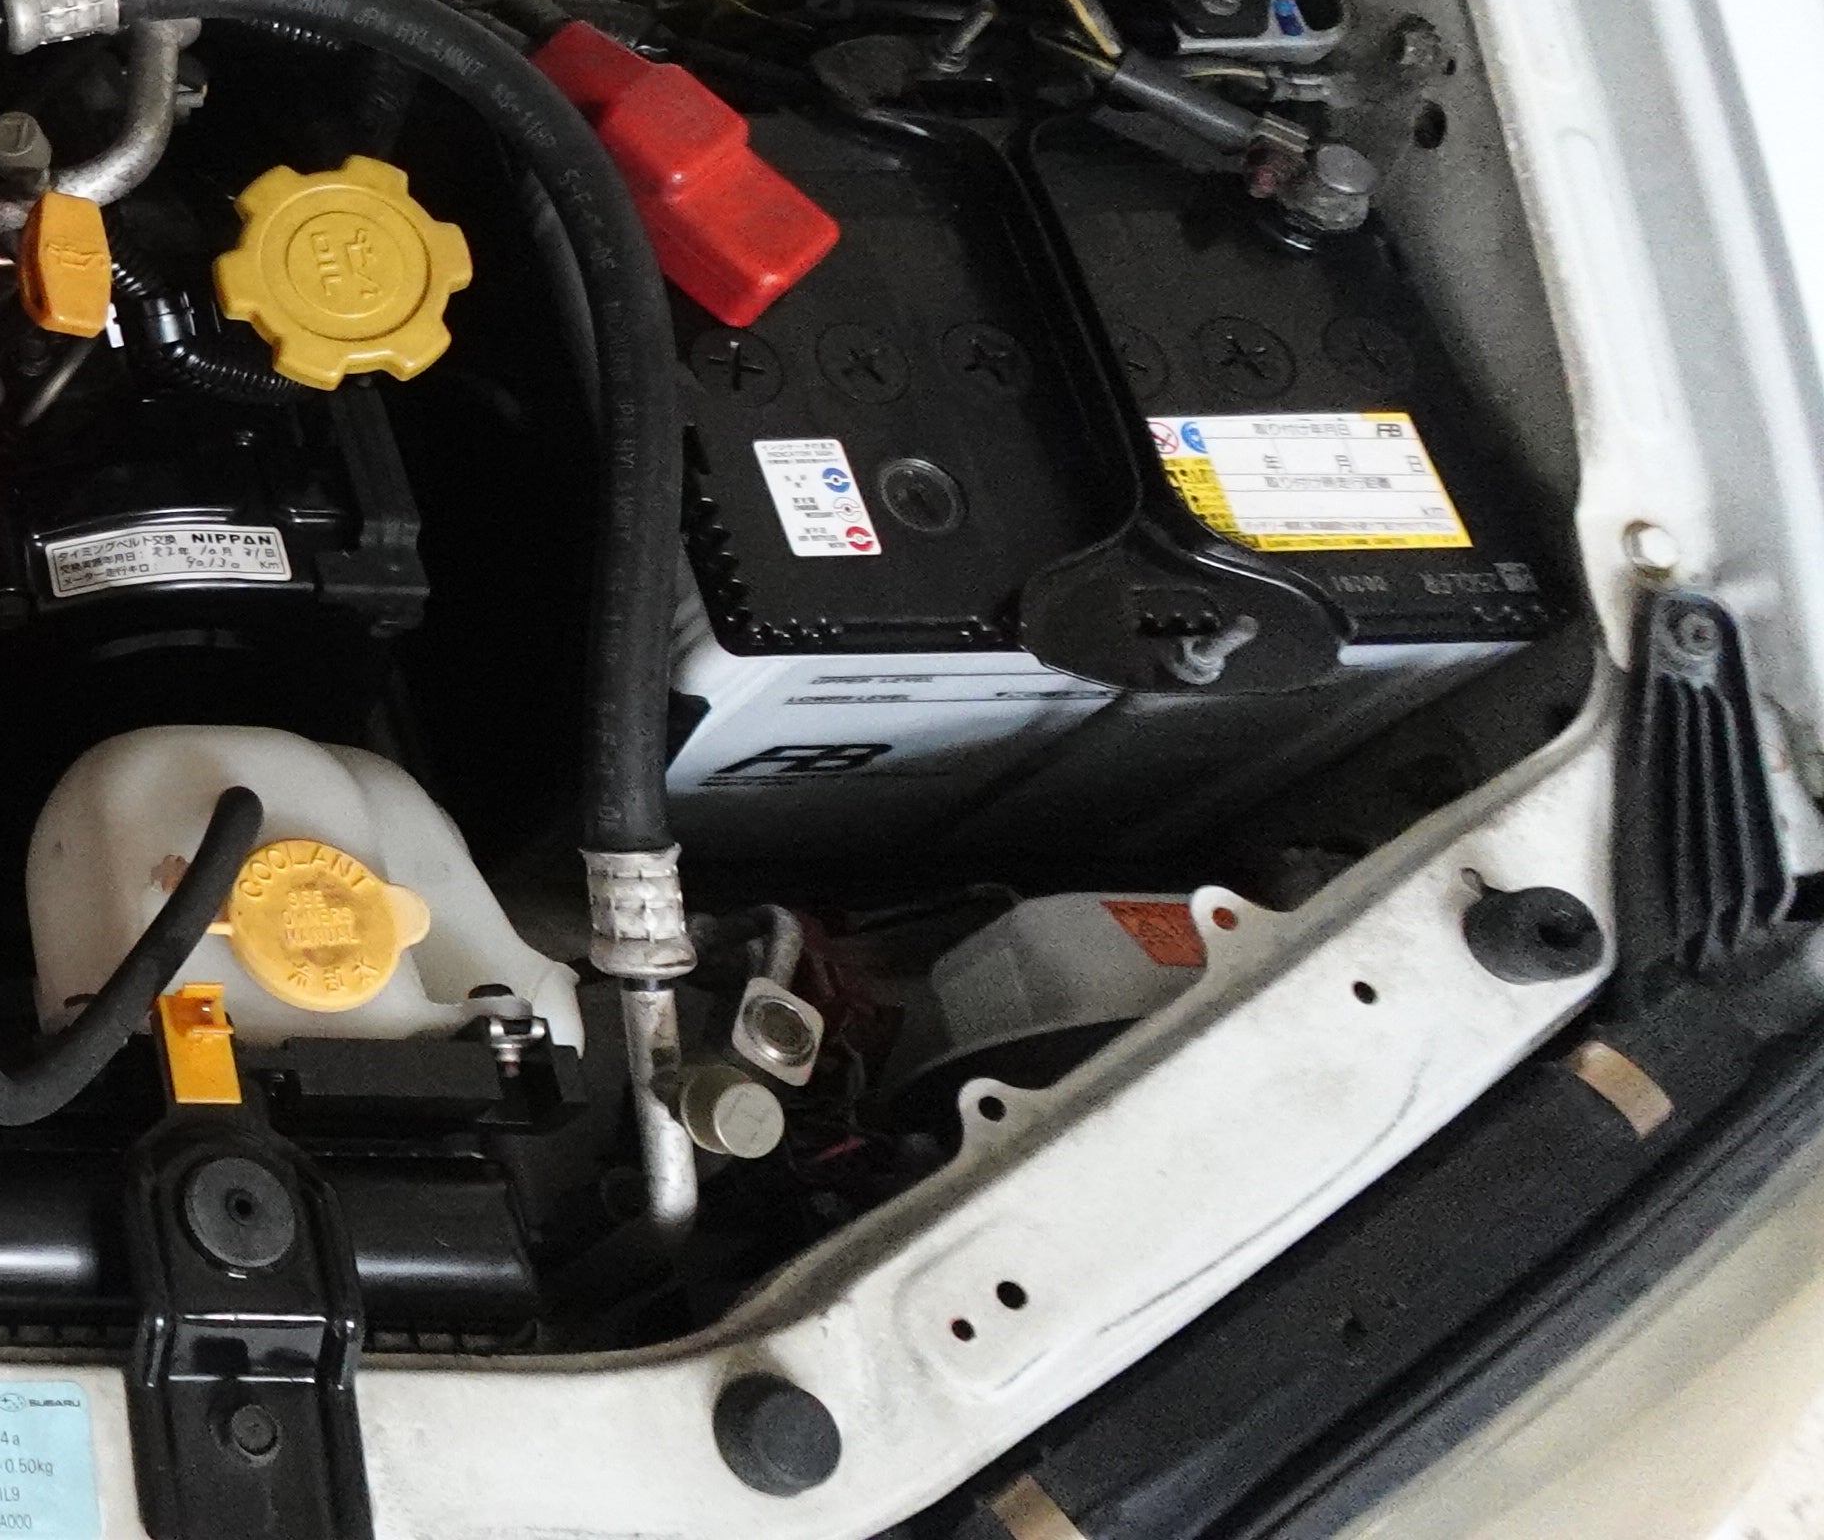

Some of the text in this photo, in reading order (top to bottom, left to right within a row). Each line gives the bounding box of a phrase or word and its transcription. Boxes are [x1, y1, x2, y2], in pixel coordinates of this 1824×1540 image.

[57, 534, 178, 561] タイミングベルト交換
[239, 843, 377, 897] COOLANT
[288, 890, 326, 909] SEE
[28, 1399, 81, 1408] SUBARU
